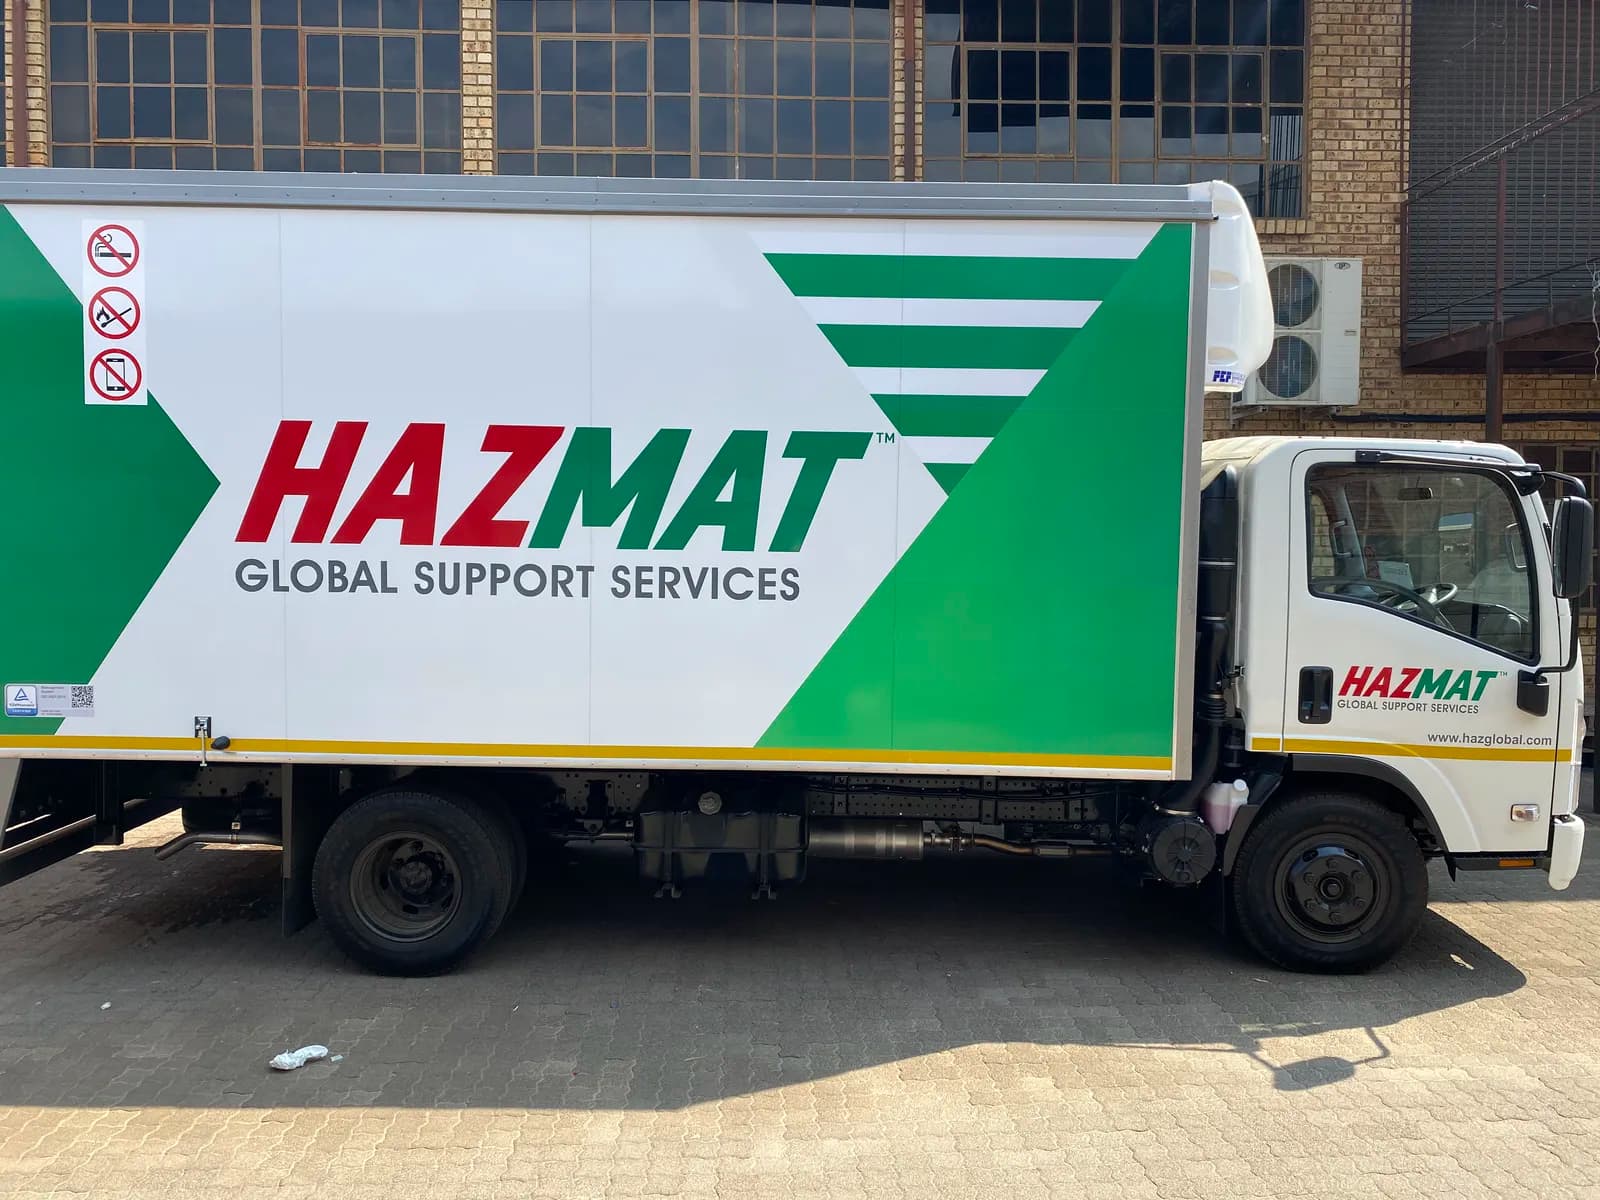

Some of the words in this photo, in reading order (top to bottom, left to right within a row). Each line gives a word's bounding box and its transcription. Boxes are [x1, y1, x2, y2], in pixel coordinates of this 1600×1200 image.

[235, 420, 874, 552] HAZMAT
[876, 432, 896, 444] TM
[235, 558, 398, 594] GLOBAL
[414, 561, 595, 597] SUPPORT
[610, 565, 800, 601] SERVICES
[1338, 666, 1499, 702] HAZMAT
[1337, 699, 1379, 711] GLOBAL
[1382, 701, 1429, 713] SUPPORT
[1431, 703, 1479, 714] SERVICES
[1428, 733, 1552, 746] www.hazglobal.com
